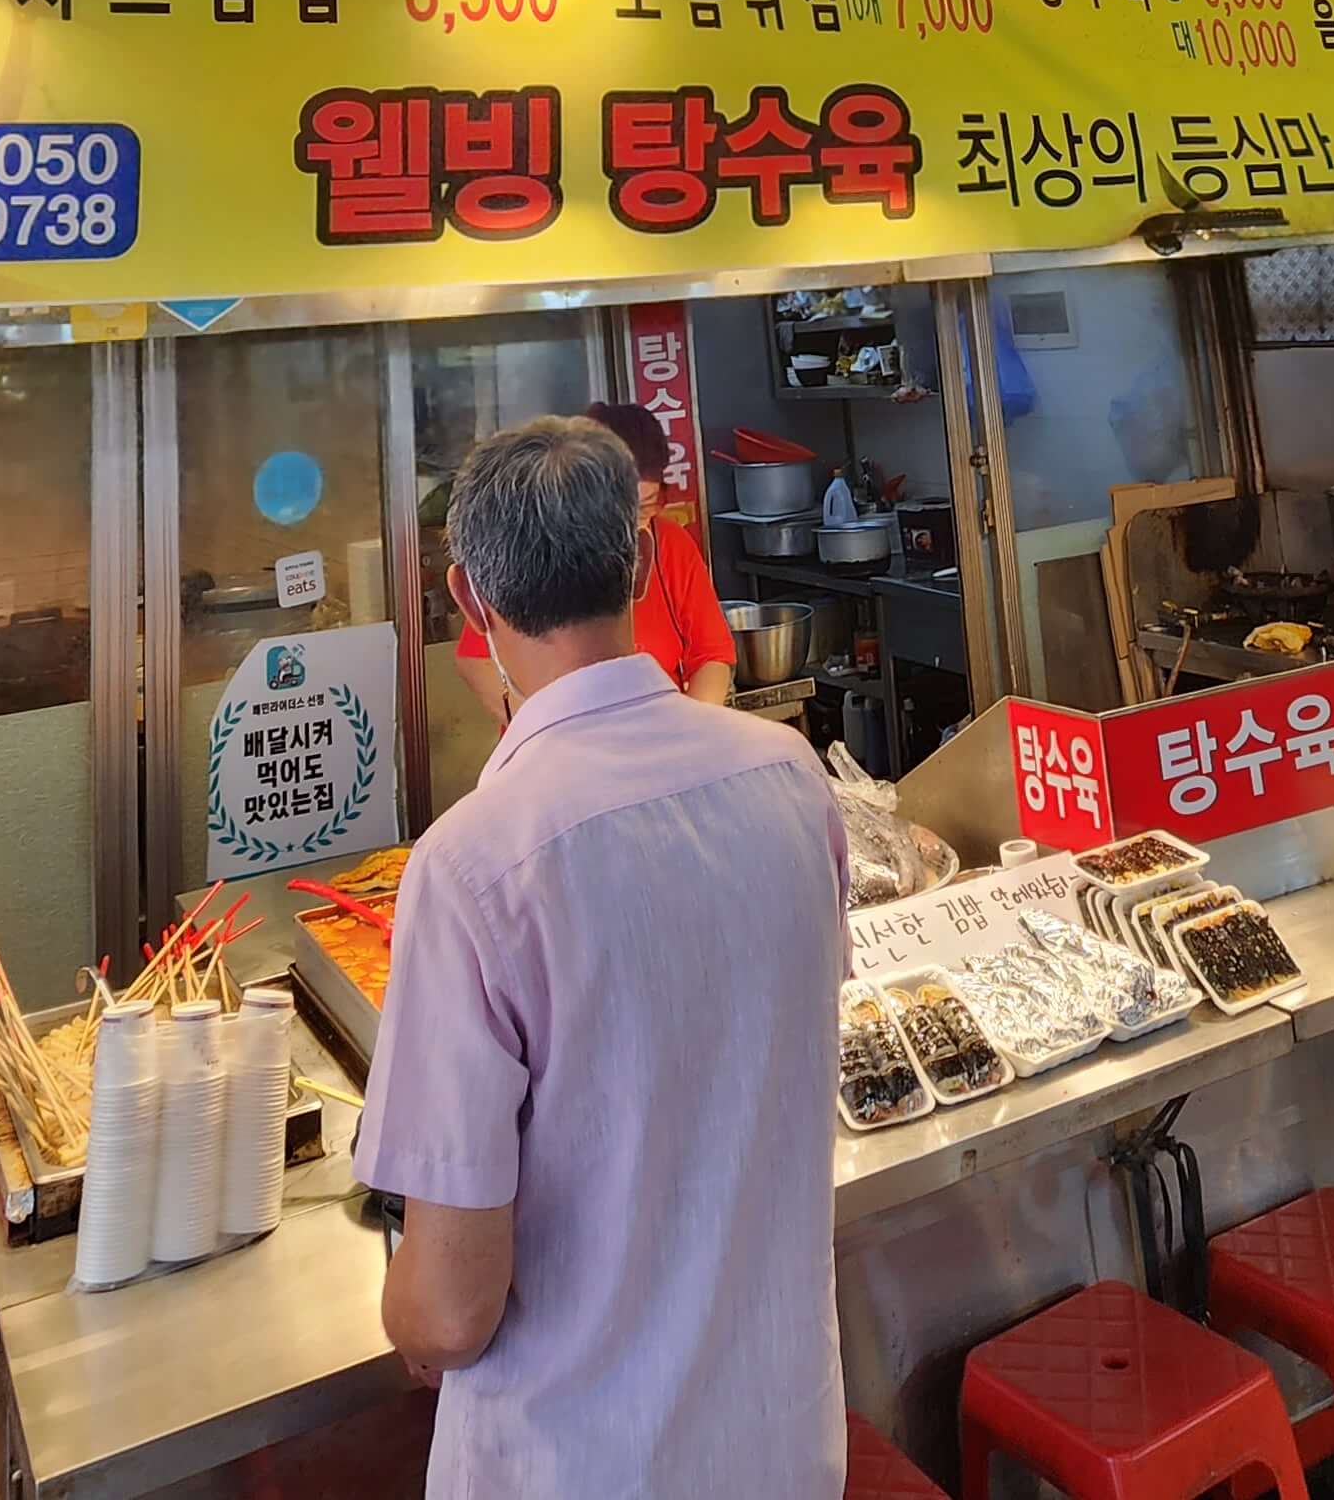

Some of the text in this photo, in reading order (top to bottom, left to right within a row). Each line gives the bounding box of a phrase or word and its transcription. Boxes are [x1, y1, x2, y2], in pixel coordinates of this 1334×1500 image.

[1170, 16, 1298, 76] 대 10,000
[295, 84, 922, 245] 웰빙 탕수육
[956, 110, 1149, 209] 최상의
[286, 579, 317, 597] eats
[243, 717, 334, 759] 배달시켜
[256, 752, 325, 789] 먹어도
[1015, 722, 1103, 830] 탕수육
[243, 780, 335, 827] 맛있는집
[935, 893, 990, 936] 김밥
